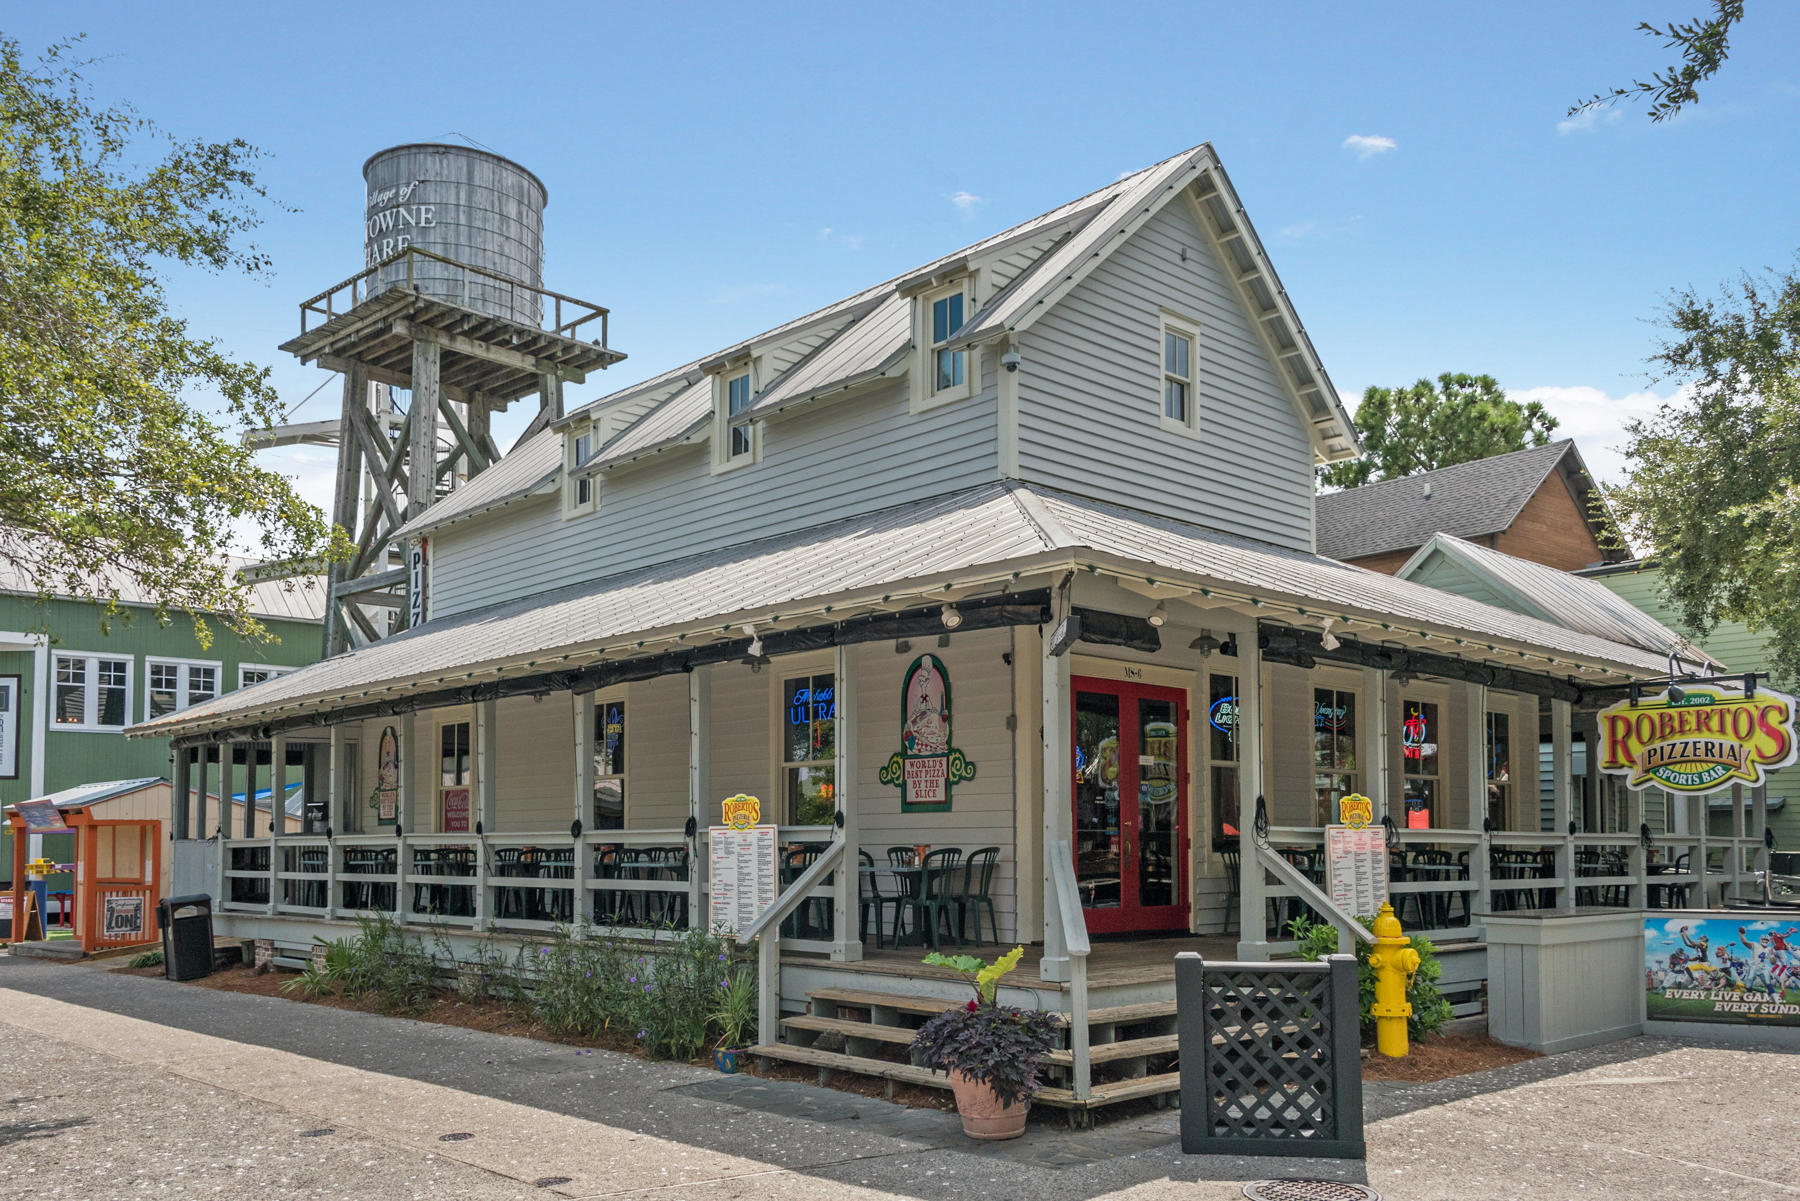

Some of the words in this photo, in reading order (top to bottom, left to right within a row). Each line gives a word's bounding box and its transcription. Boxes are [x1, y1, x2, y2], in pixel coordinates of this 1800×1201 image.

[369, 188, 396, 208] illage
[399, 181, 419, 202] of
[1690, 696, 1711, 705] 2002
[791, 702, 835, 725] ULRA
[1604, 704, 1787, 765] ROBERTO'S
[1647, 740, 1739, 765] PIZZERIA
[909, 759, 943, 770] WORLD'S
[906, 770, 923, 779] BEST
[925, 768, 946, 778] PIZZA
[1656, 766, 1699, 785] SPORTS
[1702, 765, 1727, 783] BAR
[912, 780, 922, 789] BY
[924, 779, 940, 788] THE
[915, 789, 937, 799] SLICE
[106, 902, 142, 930] ZONE
[1664, 988, 1707, 999] EVERY
[1710, 990, 1742, 1001] LIVE
[1714, 1001, 1757, 1013] EVERY
[1760, 1003, 1800, 1015] SUND
